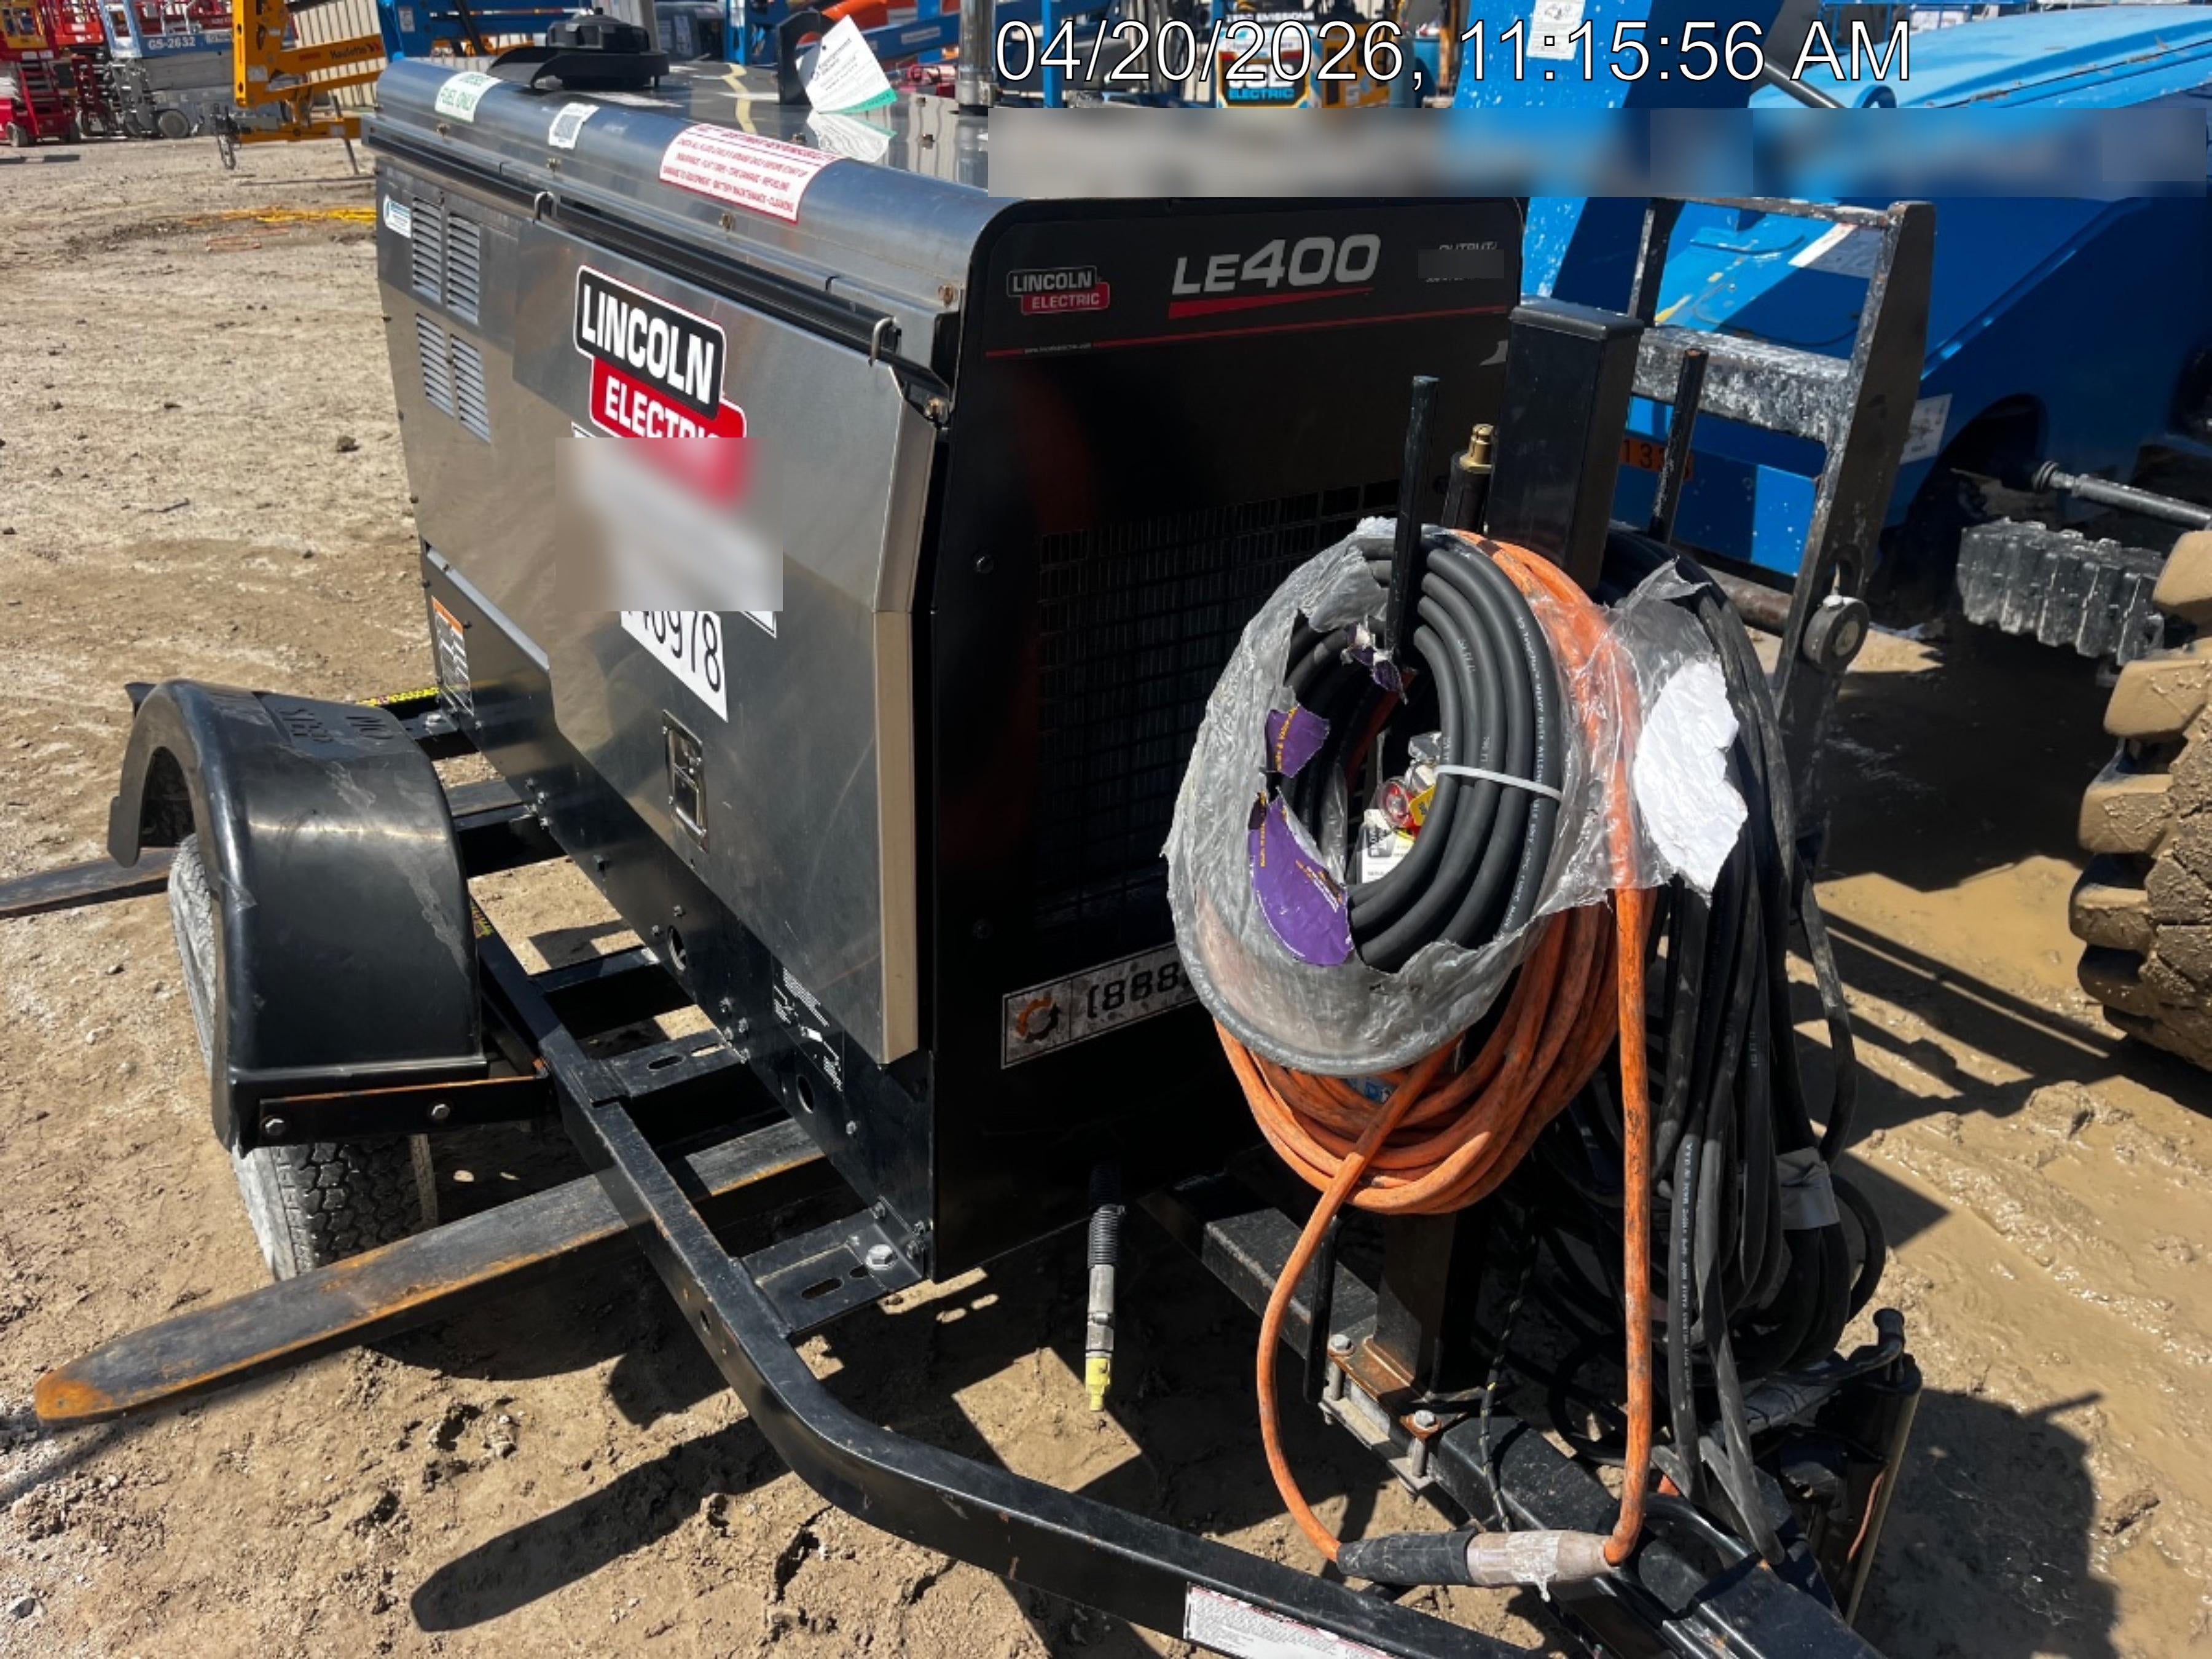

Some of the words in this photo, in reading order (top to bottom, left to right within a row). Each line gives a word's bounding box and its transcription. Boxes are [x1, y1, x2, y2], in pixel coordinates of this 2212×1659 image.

[147, 36, 195, 50] GS-2632
[1228, 88, 1295, 100] ELECTRIC
[1172, 233, 1381, 295] LE400
[1013, 270, 1092, 292] LINCOLN
[1031, 292, 1100, 310] ELECTRIC
[581, 283, 715, 406] LINCOLN
